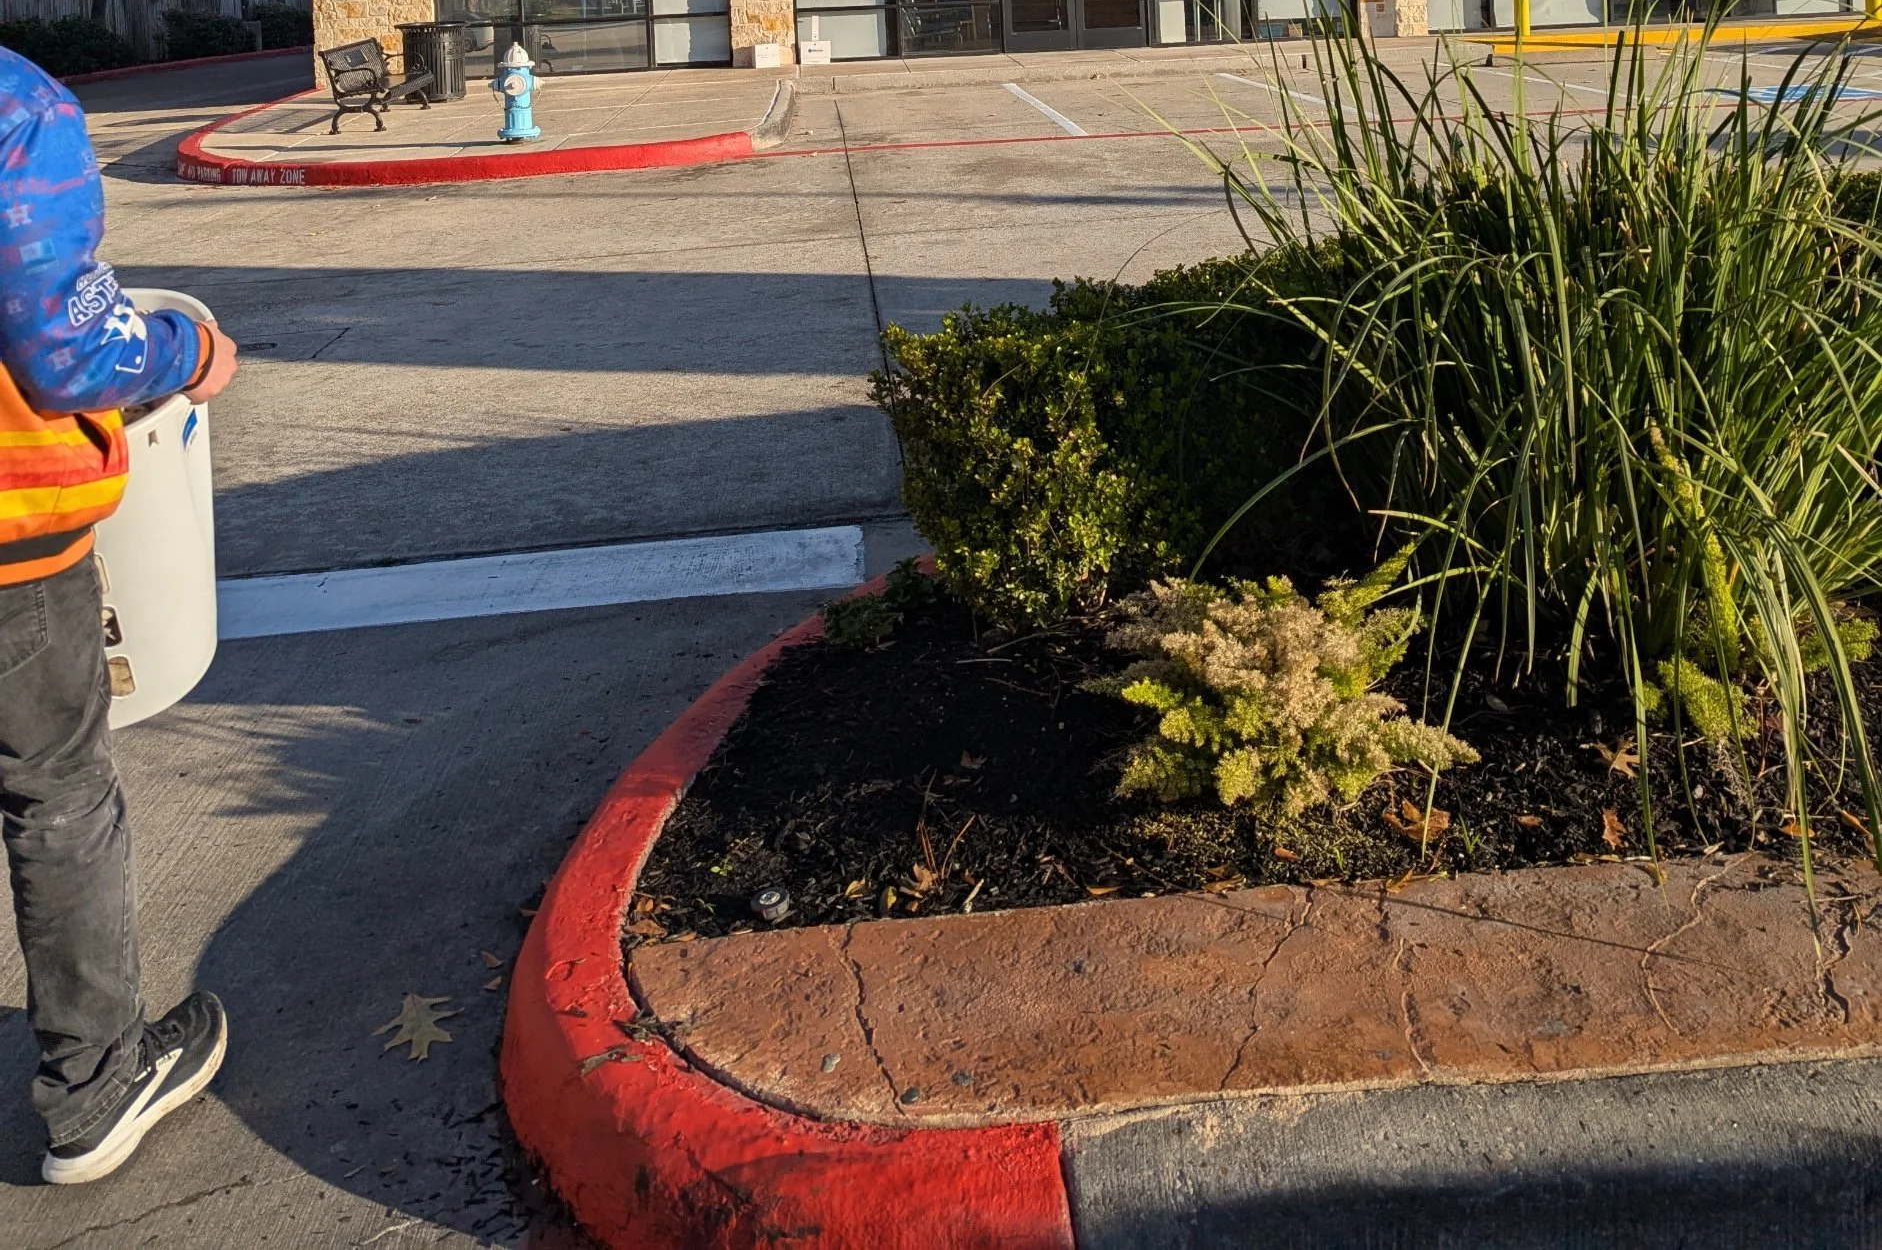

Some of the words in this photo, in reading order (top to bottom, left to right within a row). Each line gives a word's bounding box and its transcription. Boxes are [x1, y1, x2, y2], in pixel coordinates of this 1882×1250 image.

[197, 166, 221, 181] PARKING
[232, 168, 248, 183] TOW
[250, 168, 275, 183] AWAY
[280, 168, 306, 184] ZONE
